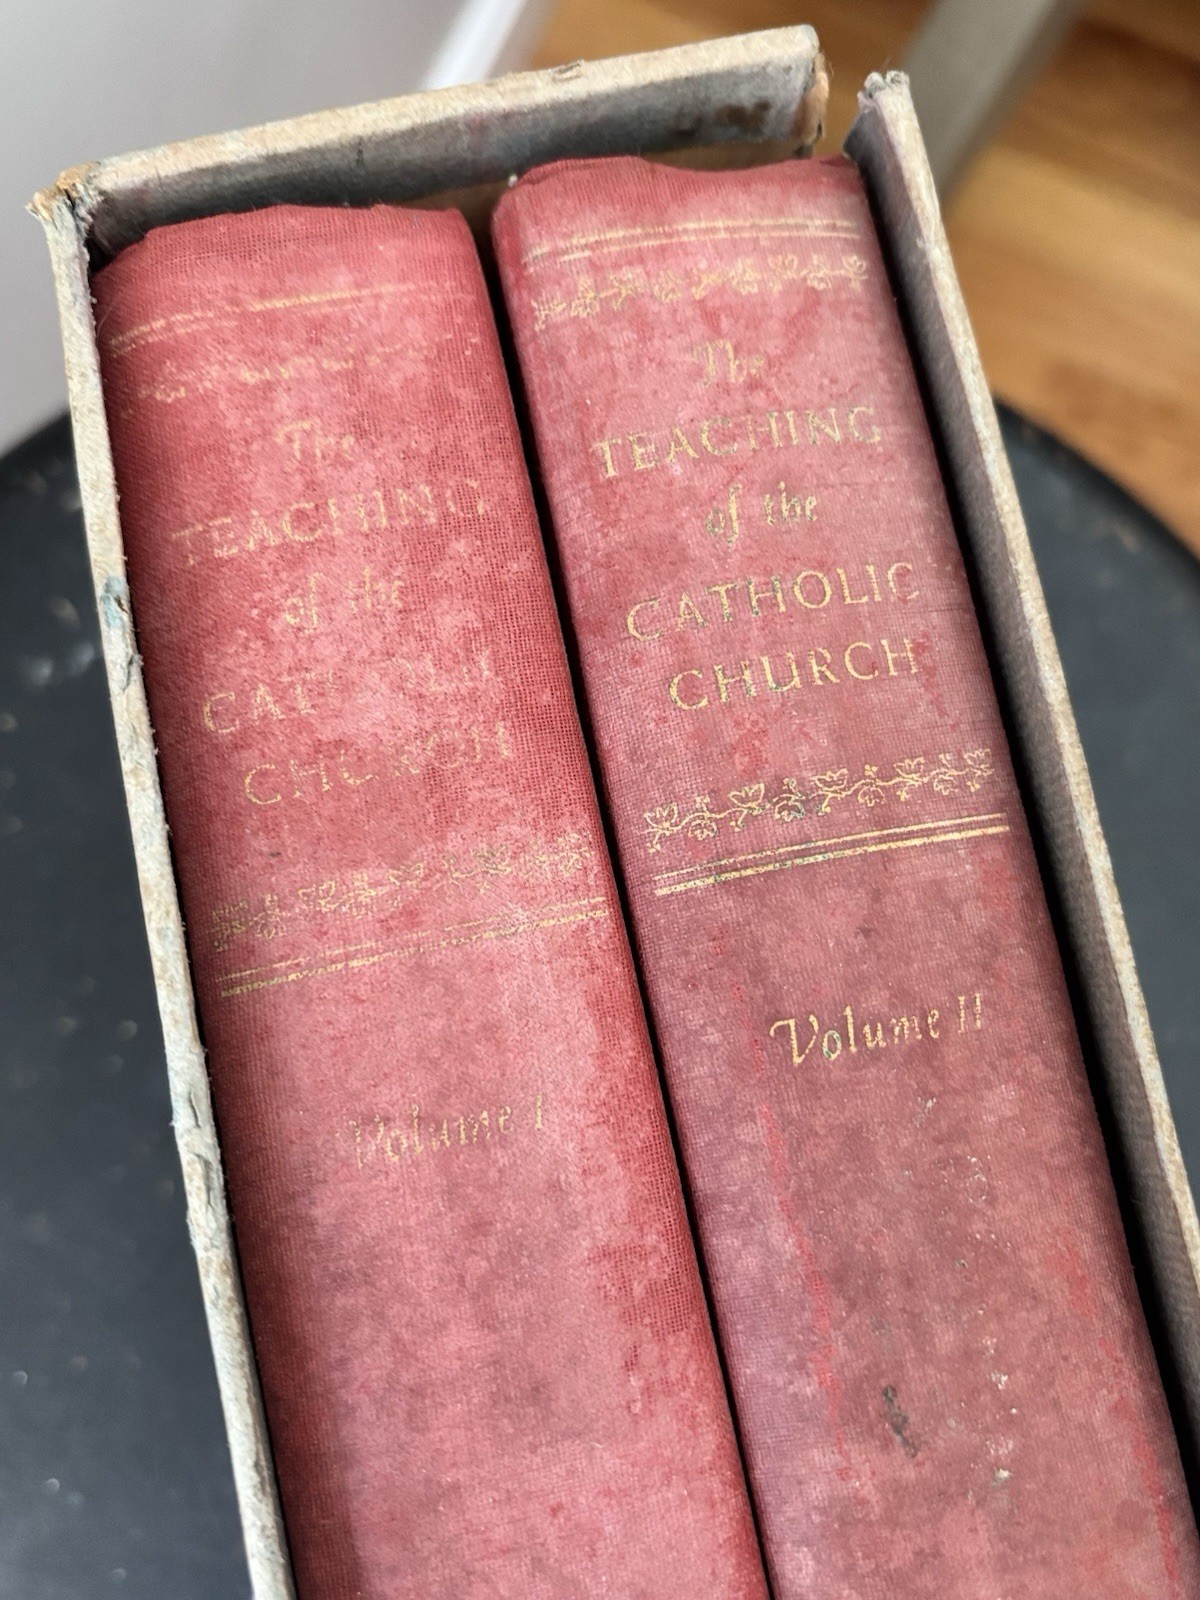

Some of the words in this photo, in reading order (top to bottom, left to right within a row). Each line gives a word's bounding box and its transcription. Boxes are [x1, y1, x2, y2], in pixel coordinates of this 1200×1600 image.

[592, 406, 882, 479] TEACHING
[705, 482, 743, 548] of
[763, 480, 818, 526] the
[626, 561, 920, 642] CATHOLIC
[668, 637, 919, 711] CHURCH
[769, 1004, 940, 1067] Volume
[957, 992, 983, 1034] II
[334, 1103, 512, 1170] Volume
